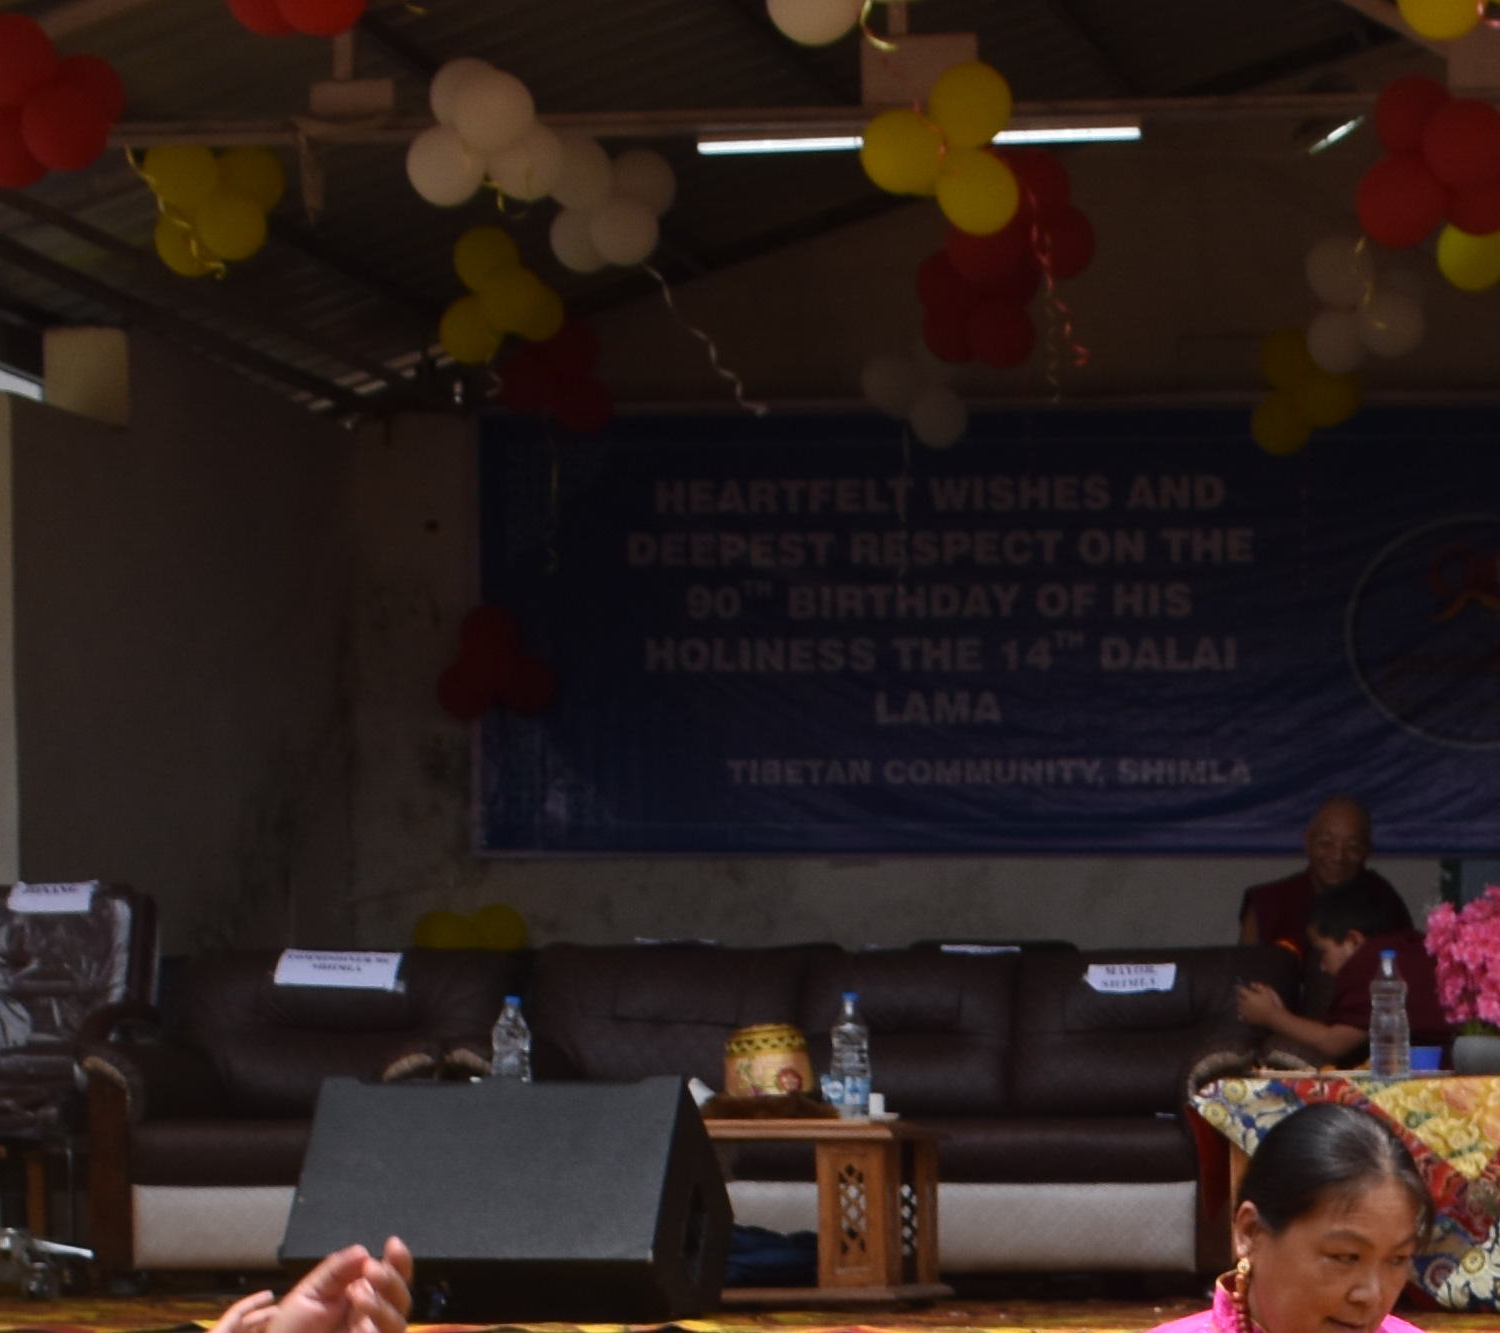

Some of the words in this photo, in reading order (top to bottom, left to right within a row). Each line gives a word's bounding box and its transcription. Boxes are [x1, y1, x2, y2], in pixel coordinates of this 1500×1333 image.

[655, 476, 914, 514] HEARTFELT
[928, 473, 1112, 512] WISHES
[1126, 472, 1227, 510] AND
[627, 530, 835, 567] DEEPEST
[851, 528, 1064, 566] RESPECT
[1077, 527, 1146, 566] ON
[1161, 526, 1256, 564] THE
[787, 582, 1021, 620] BIRTHDAY
[1034, 581, 1098, 618] OF
[1111, 581, 1194, 619] HIS
[644, 636, 878, 673] HOLINESS
[891, 636, 983, 672] THE
[1100, 634, 1239, 671] DALAI
[874, 689, 1003, 725] LAMA
[726, 757, 873, 786] TIBETAN
[882, 756, 1105, 788] COMMUNITY,
[1117, 756, 1253, 786] SHIMLA
